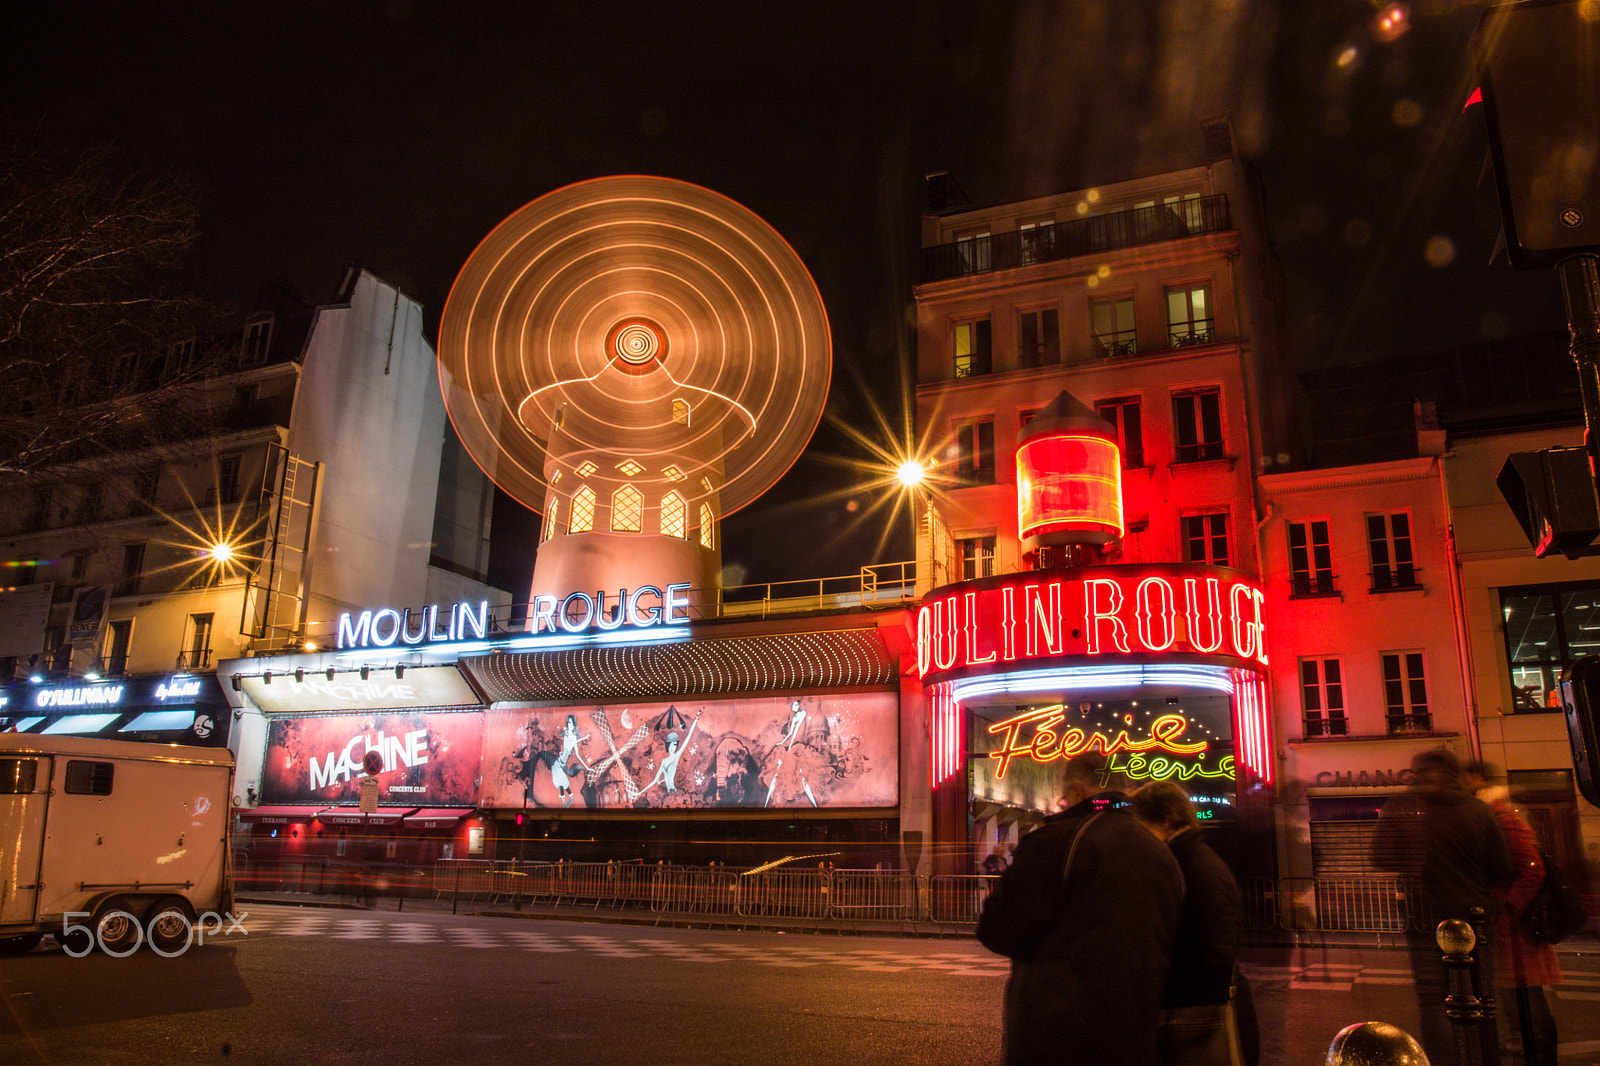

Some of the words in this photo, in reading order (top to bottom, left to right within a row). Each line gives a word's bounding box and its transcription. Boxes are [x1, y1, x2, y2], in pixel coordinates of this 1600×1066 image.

[339, 600, 488, 648] MOULIN
[531, 582, 692, 634] ROUGE
[1084, 577, 1269, 665] ROUGE
[37, 686, 124, 707] O'SULLIVANS
[309, 729, 429, 791] MACHINE
[988, 704, 1208, 780] Féerie
[414, 785, 427, 793] CLUB
[1316, 768, 1417, 787] CHANG
[332, 817, 361, 825] CONCERTS
[369, 817, 385, 825] CLUB
